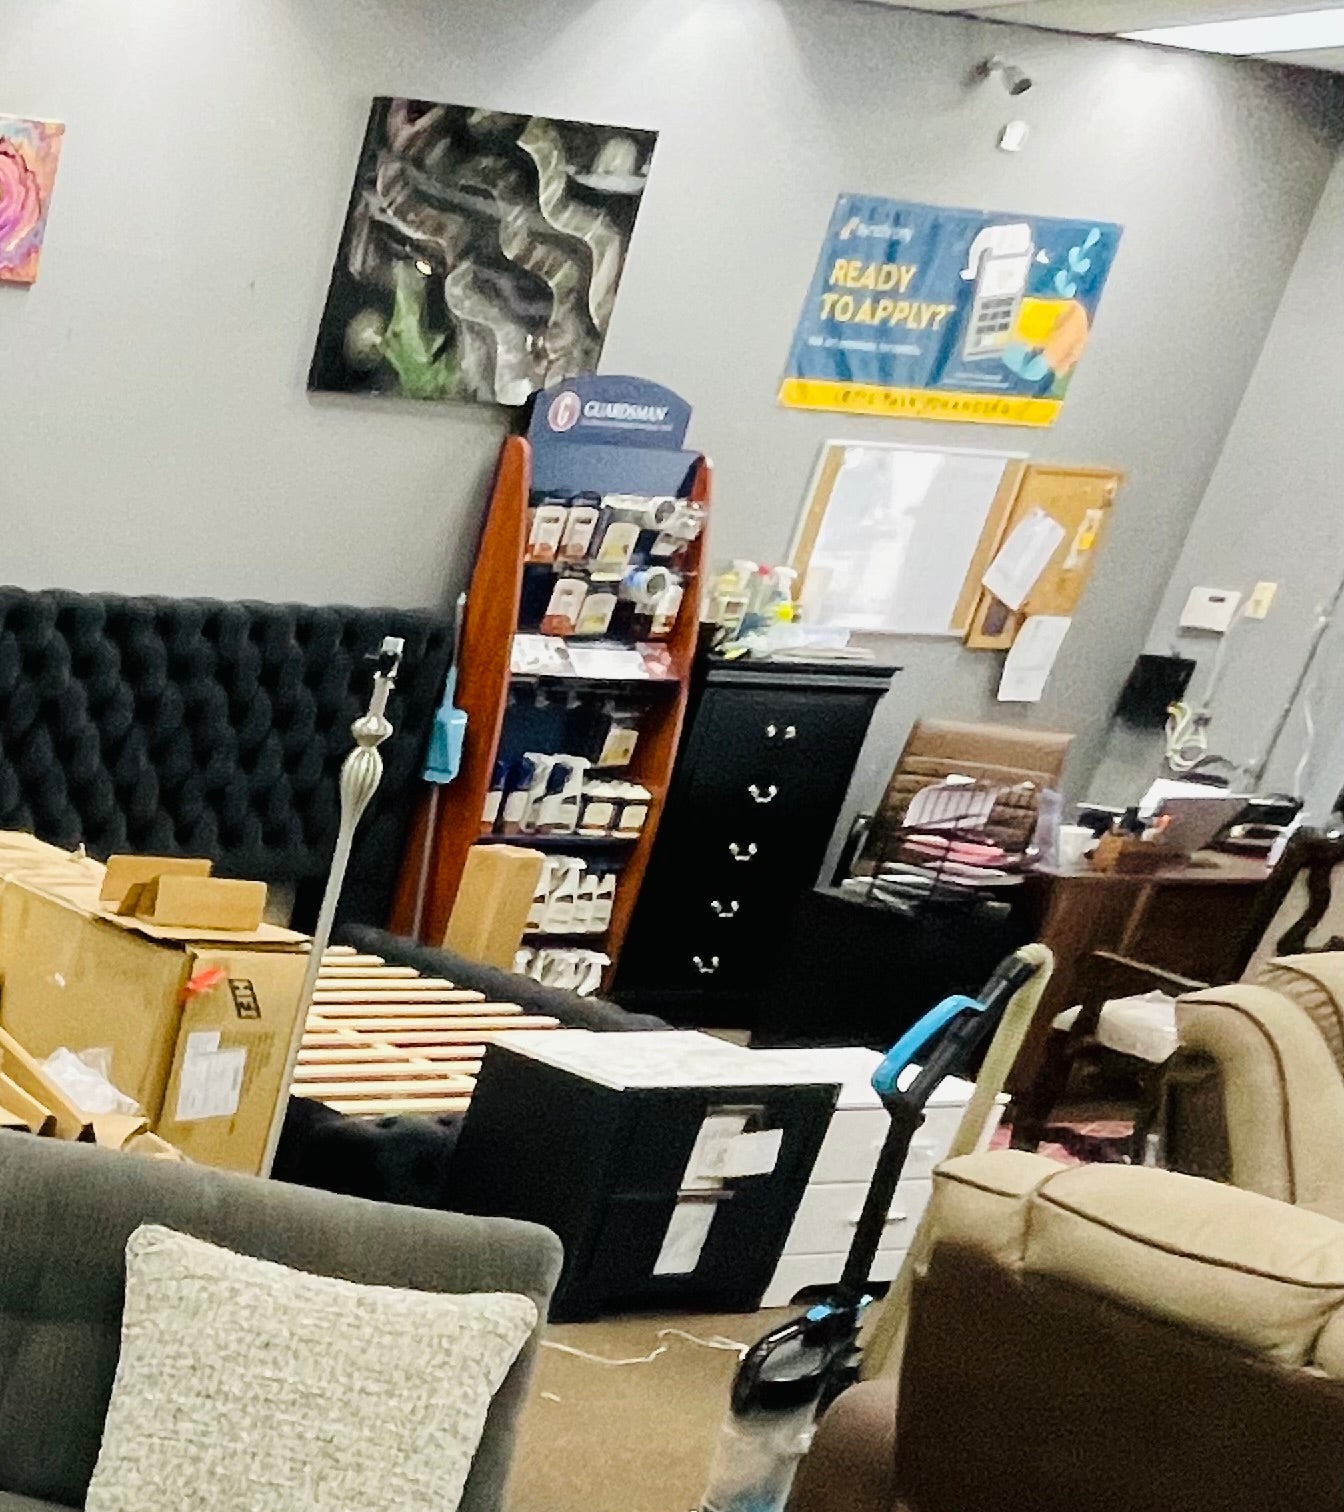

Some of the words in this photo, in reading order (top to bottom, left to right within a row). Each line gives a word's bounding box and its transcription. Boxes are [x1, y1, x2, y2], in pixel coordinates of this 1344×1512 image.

[829, 258, 918, 293] READY
[820, 292, 853, 322] TO
[584, 400, 669, 421] GUARDSMAN
